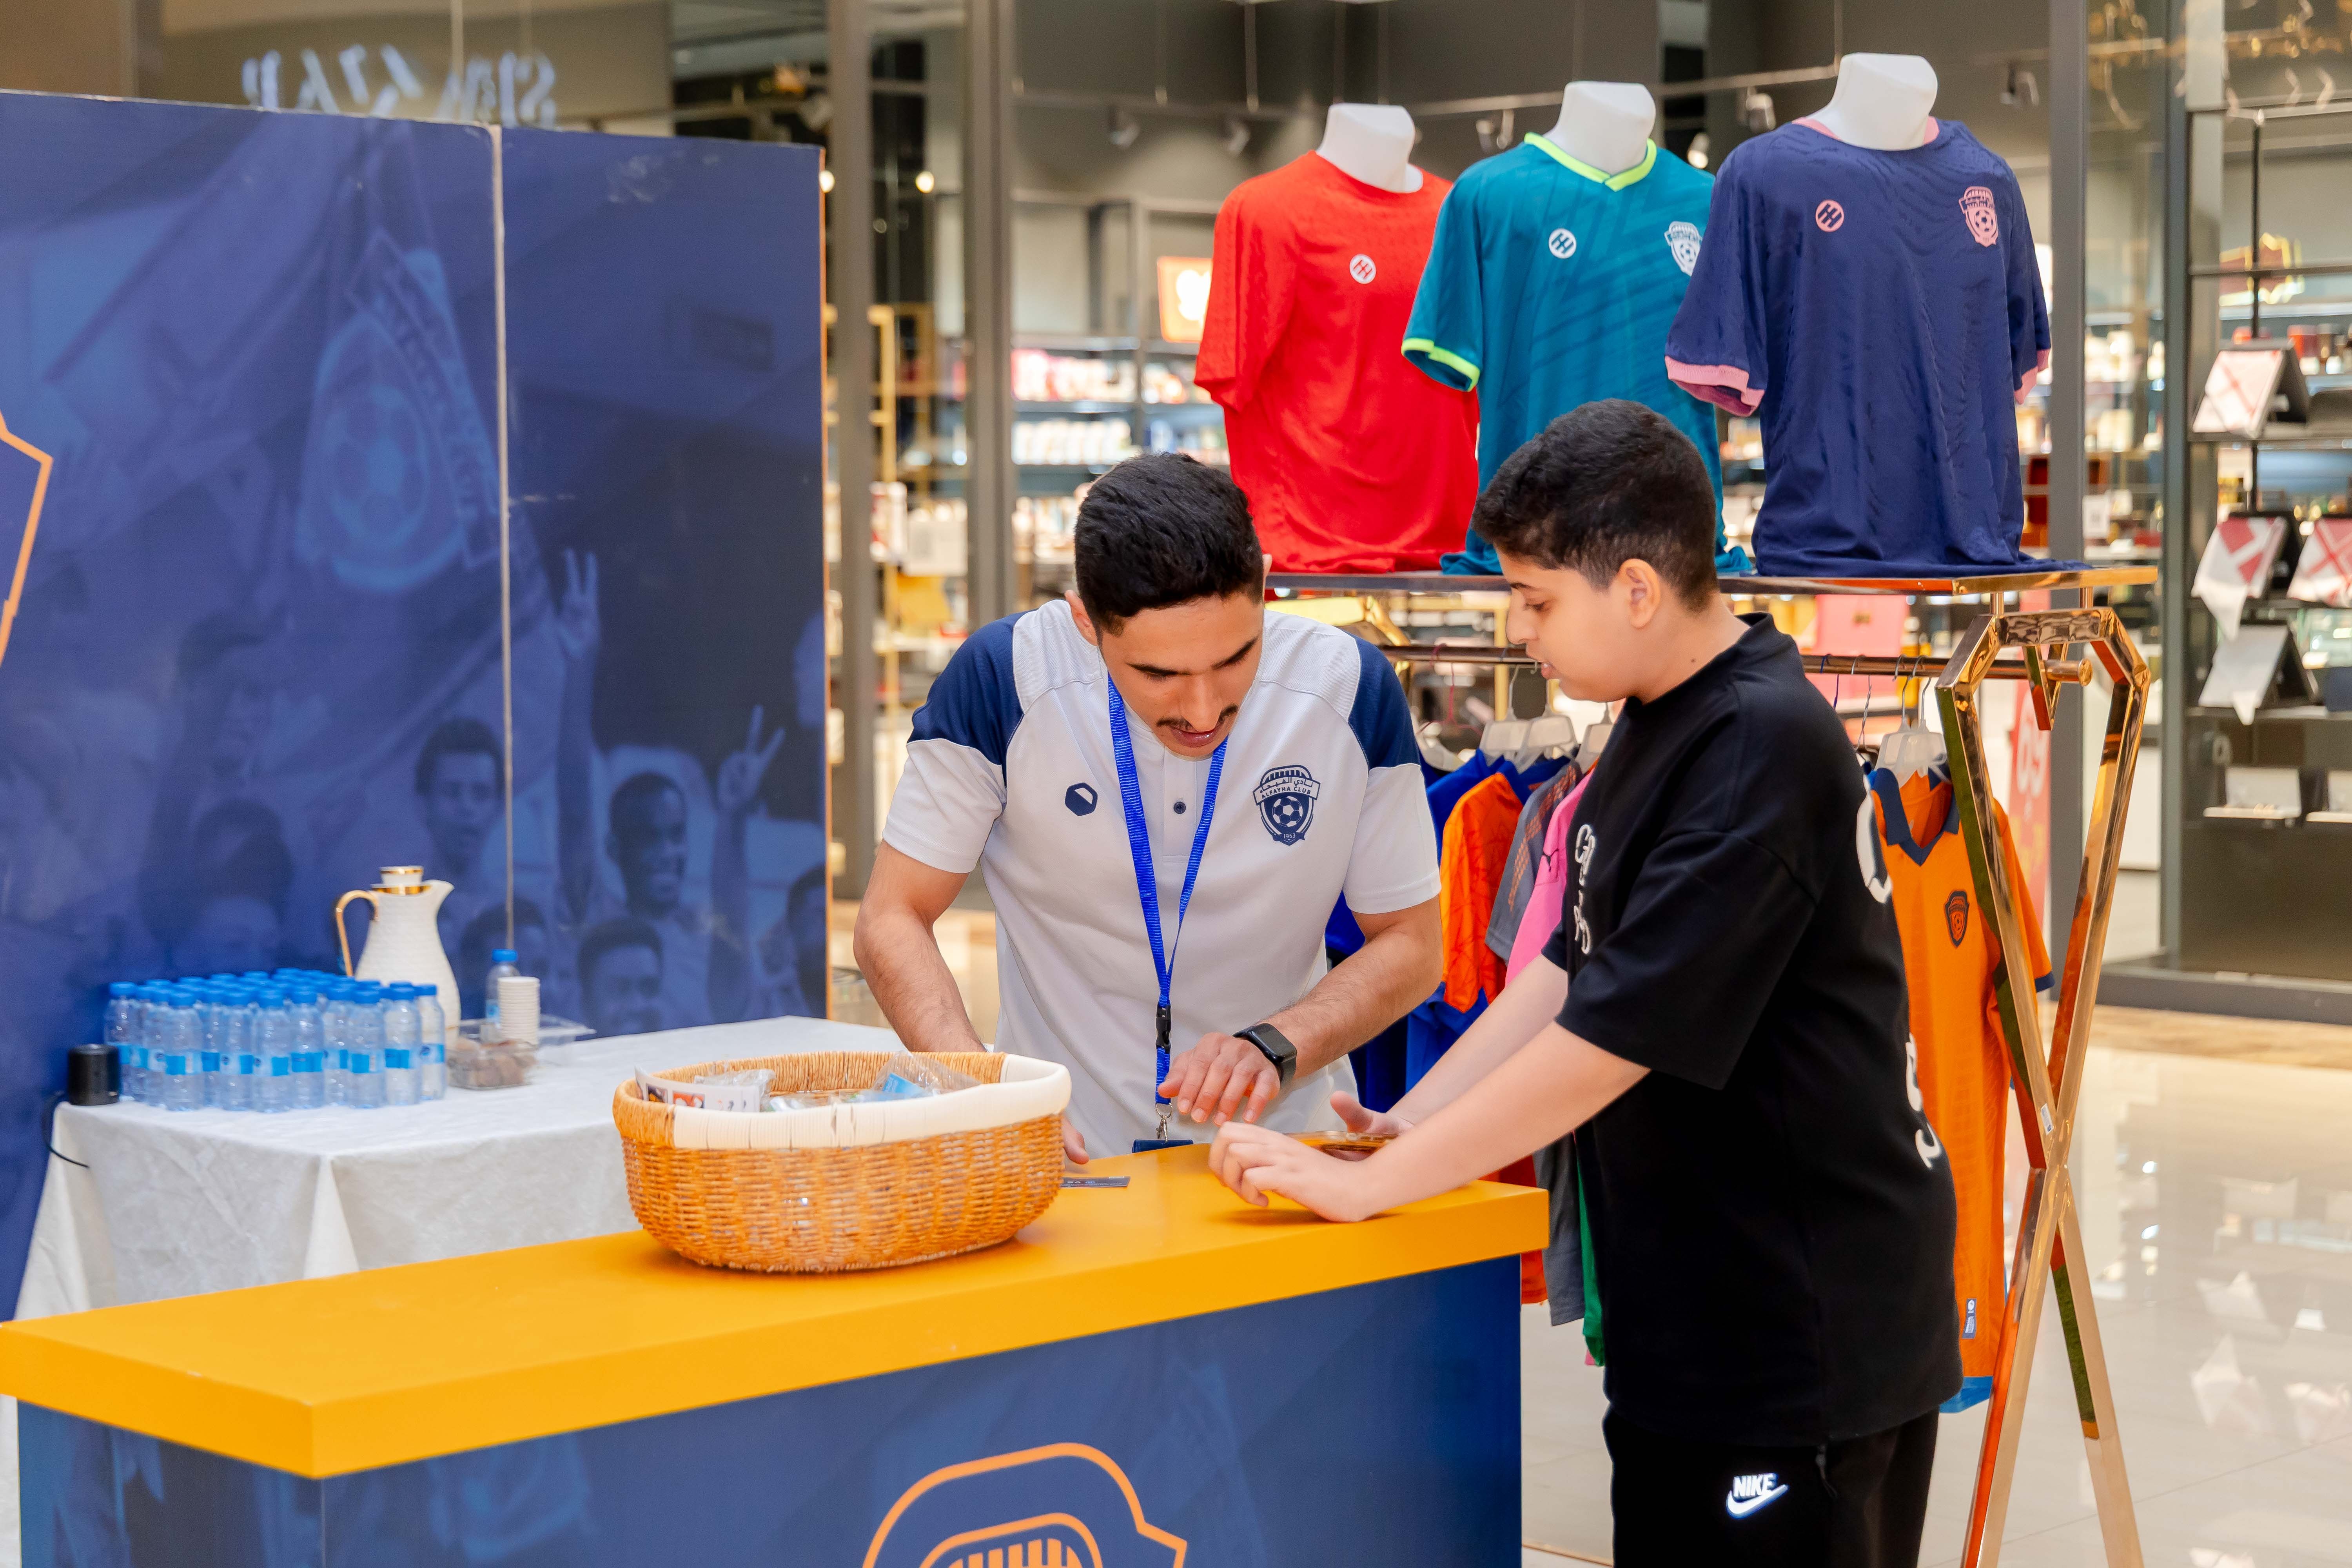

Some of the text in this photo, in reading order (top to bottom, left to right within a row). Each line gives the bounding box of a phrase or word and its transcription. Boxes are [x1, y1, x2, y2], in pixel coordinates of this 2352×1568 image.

[1294, 779, 1313, 787] نادي
[1261, 786, 1311, 799] ALFAYHA CLUB
[1733, 1473, 1775, 1497] NIKE
